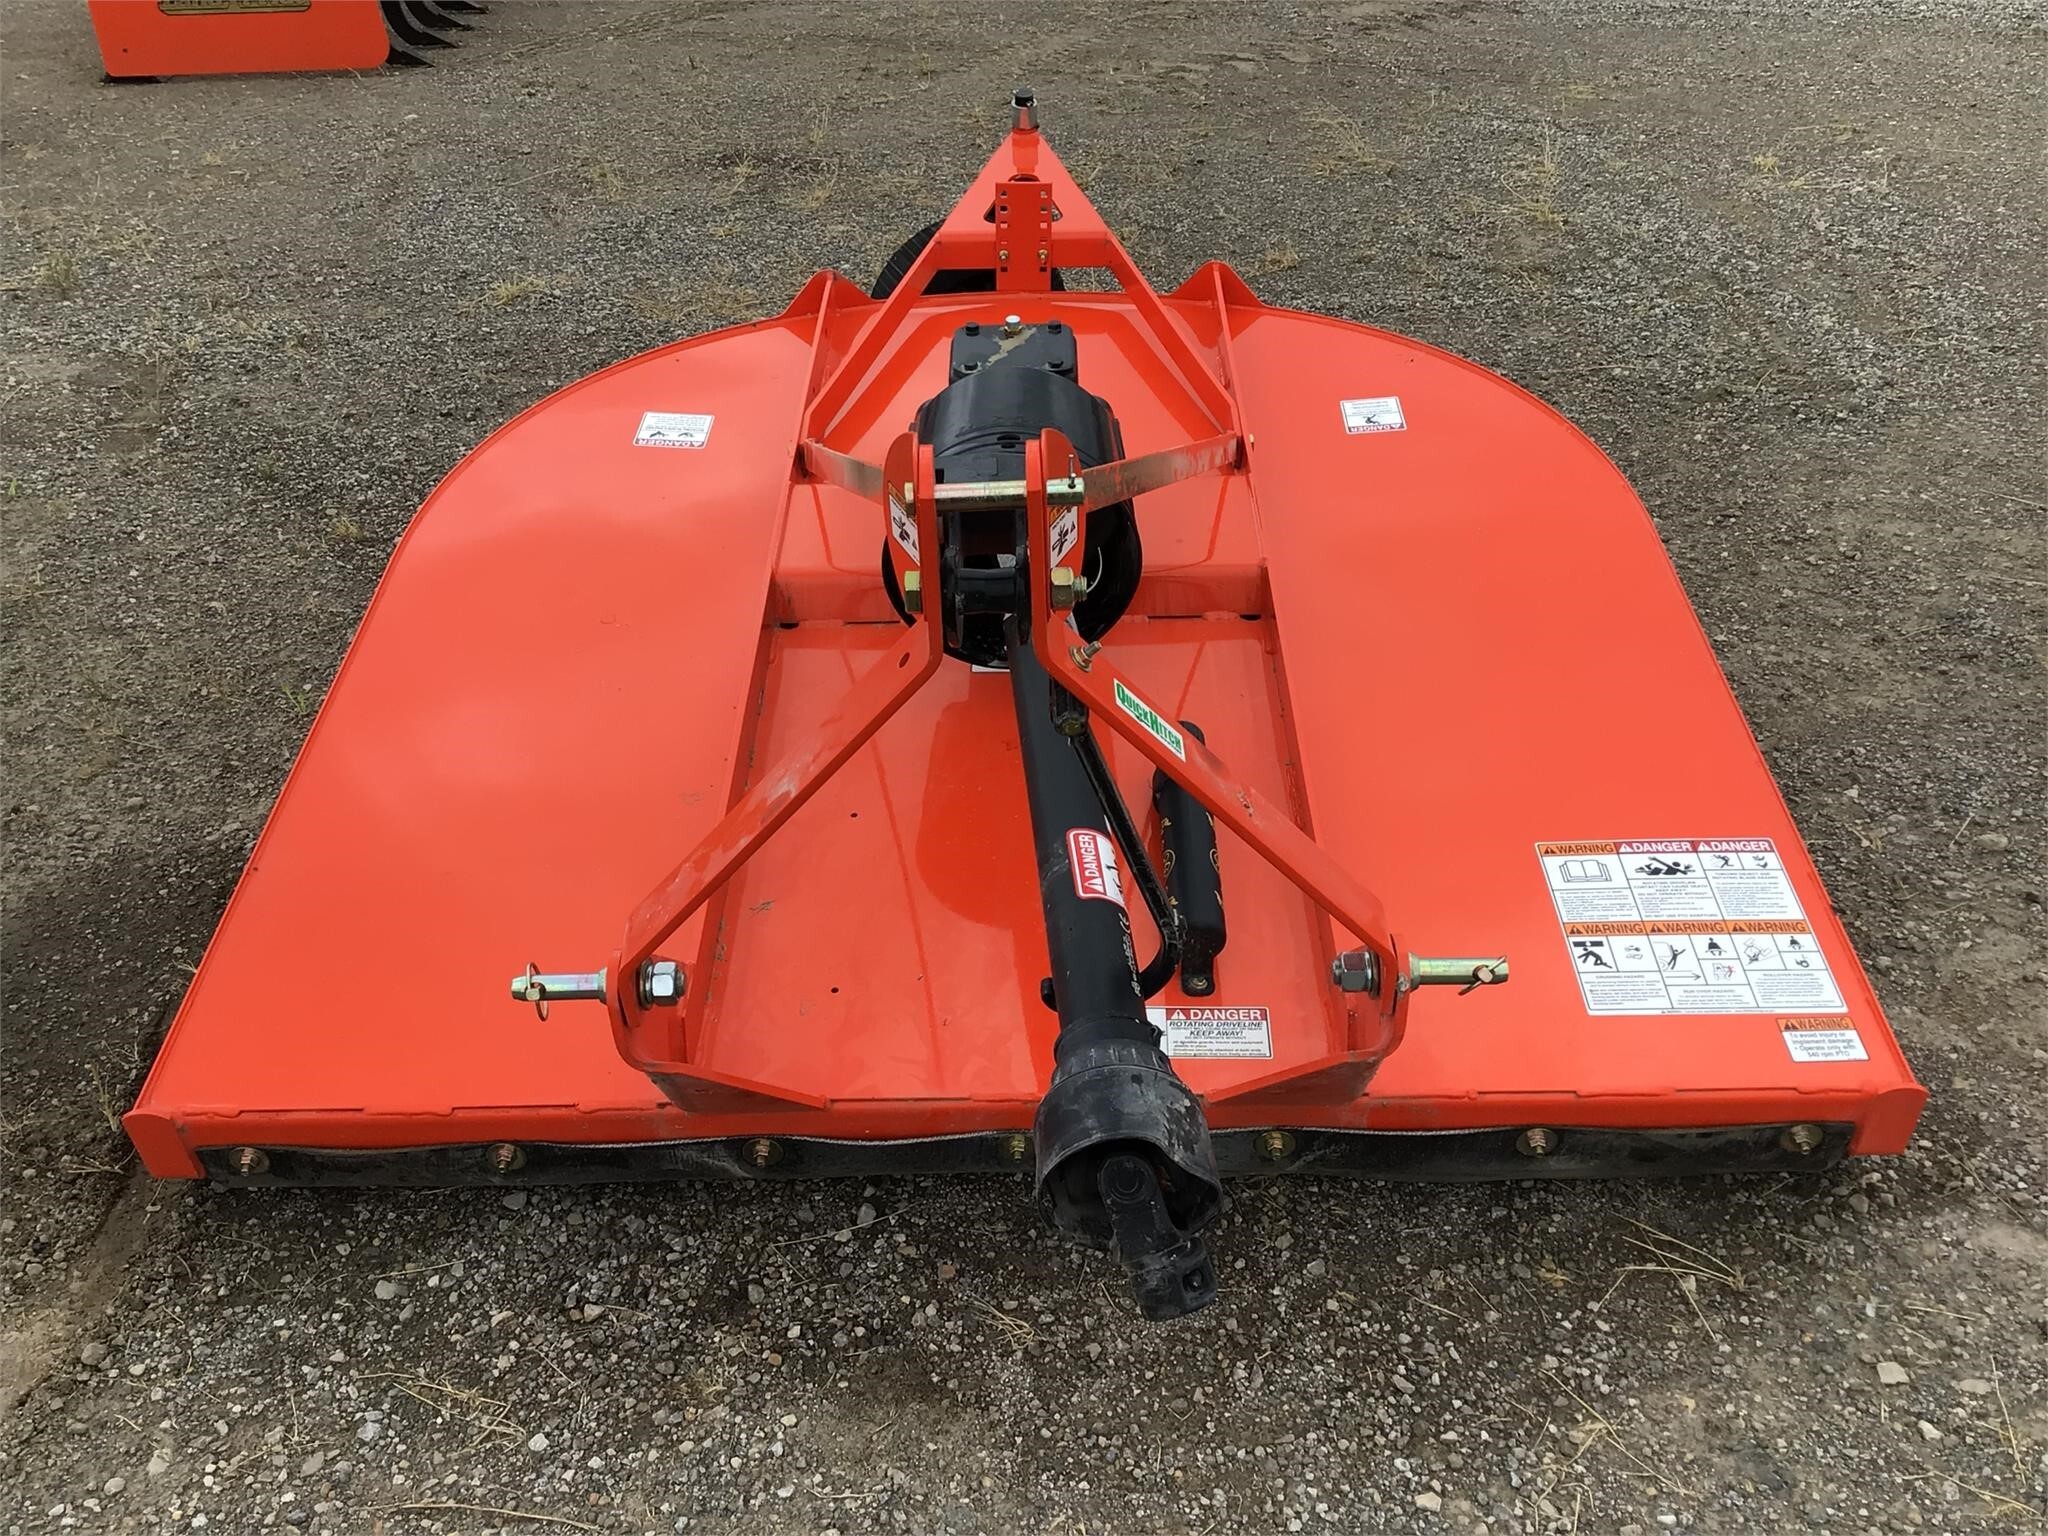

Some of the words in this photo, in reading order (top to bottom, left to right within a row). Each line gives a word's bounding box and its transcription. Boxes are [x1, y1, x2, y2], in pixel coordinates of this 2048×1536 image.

[638, 438, 691, 447] DANGER
[1556, 843, 1614, 854] WARNING
[1632, 841, 1692, 853] DANGER
[1710, 841, 1771, 852] DANGER
[1079, 834, 1099, 877] DANGER
[1582, 923, 1645, 934] WARNING
[1663, 922, 1725, 933] WARNING
[1744, 921, 1806, 932] WARNING
[1190, 1009, 1262, 1020] DANGER
[1799, 1018, 1850, 1029] WARNING
